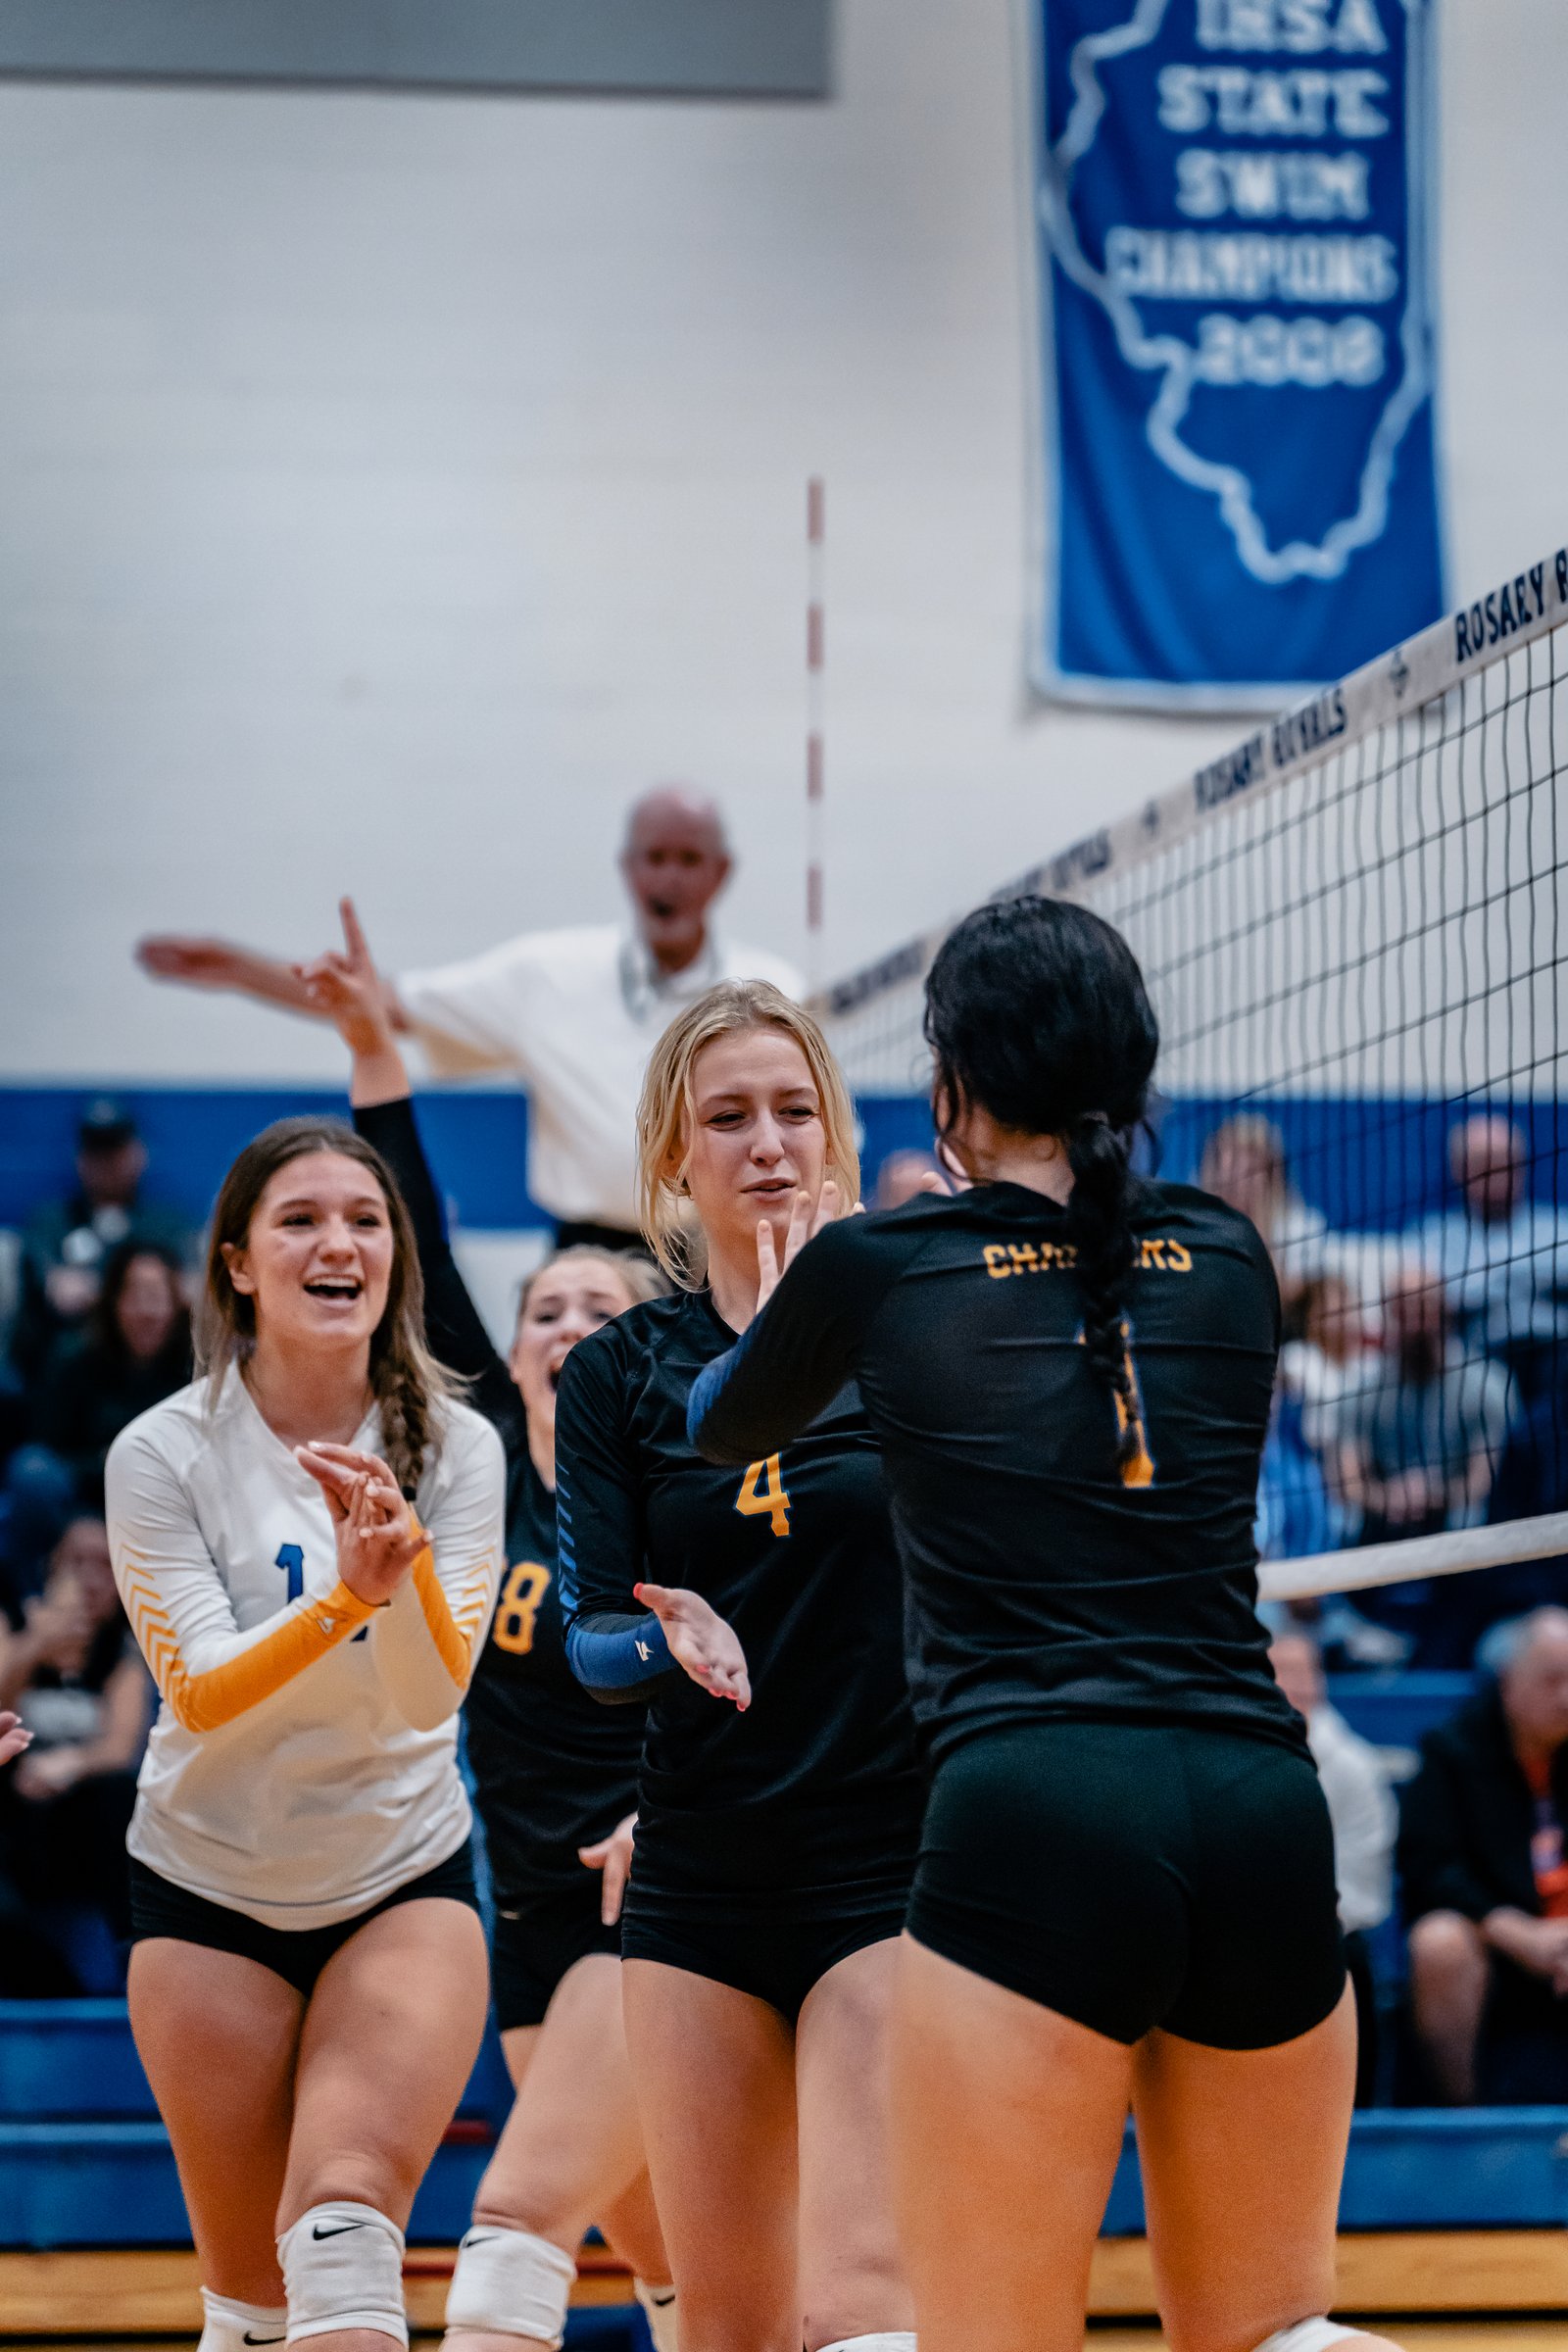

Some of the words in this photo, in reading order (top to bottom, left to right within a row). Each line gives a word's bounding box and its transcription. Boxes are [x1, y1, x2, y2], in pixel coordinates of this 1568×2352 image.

[1158, 65, 1390, 138] STATE
[1177, 149, 1369, 220] SWIM
[1105, 226, 1398, 304] CHAMPIONS
[735, 1451, 792, 1538] 4
[493, 1556, 551, 1654] 8
